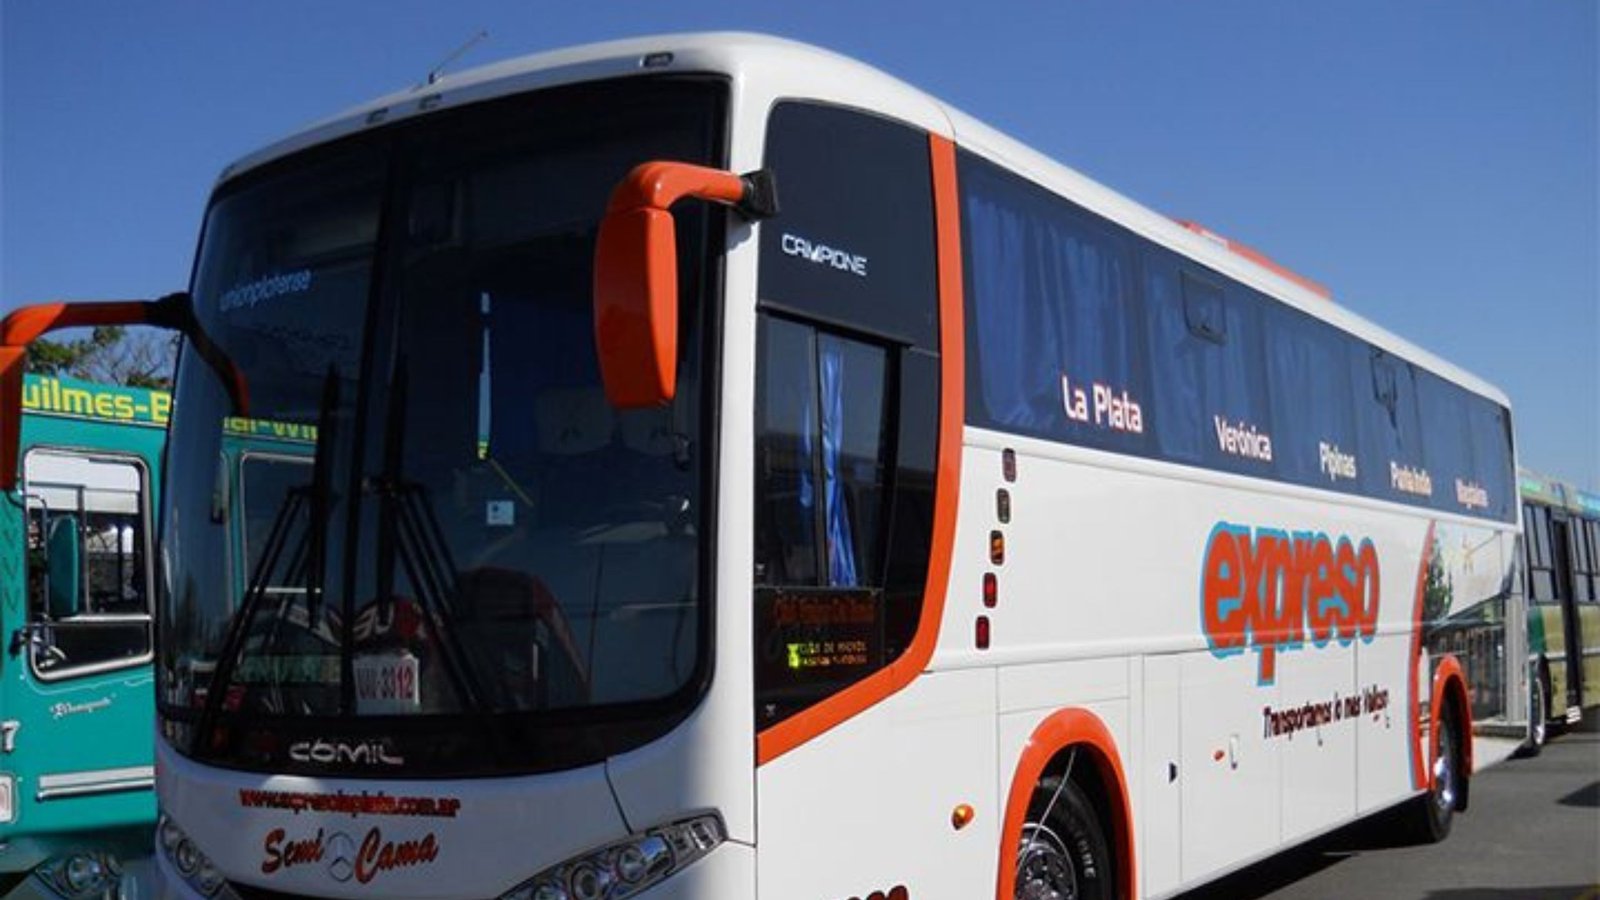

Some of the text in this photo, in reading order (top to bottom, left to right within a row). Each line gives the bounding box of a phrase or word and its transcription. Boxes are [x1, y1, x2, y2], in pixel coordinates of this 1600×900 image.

[781, 233, 867, 277] CAMPIONE
[1061, 374, 1144, 434] La Plata
[1214, 414, 1273, 461] Verónica
[1201, 521, 1381, 686] expreso
[261, 826, 440, 884] Semi Cama
